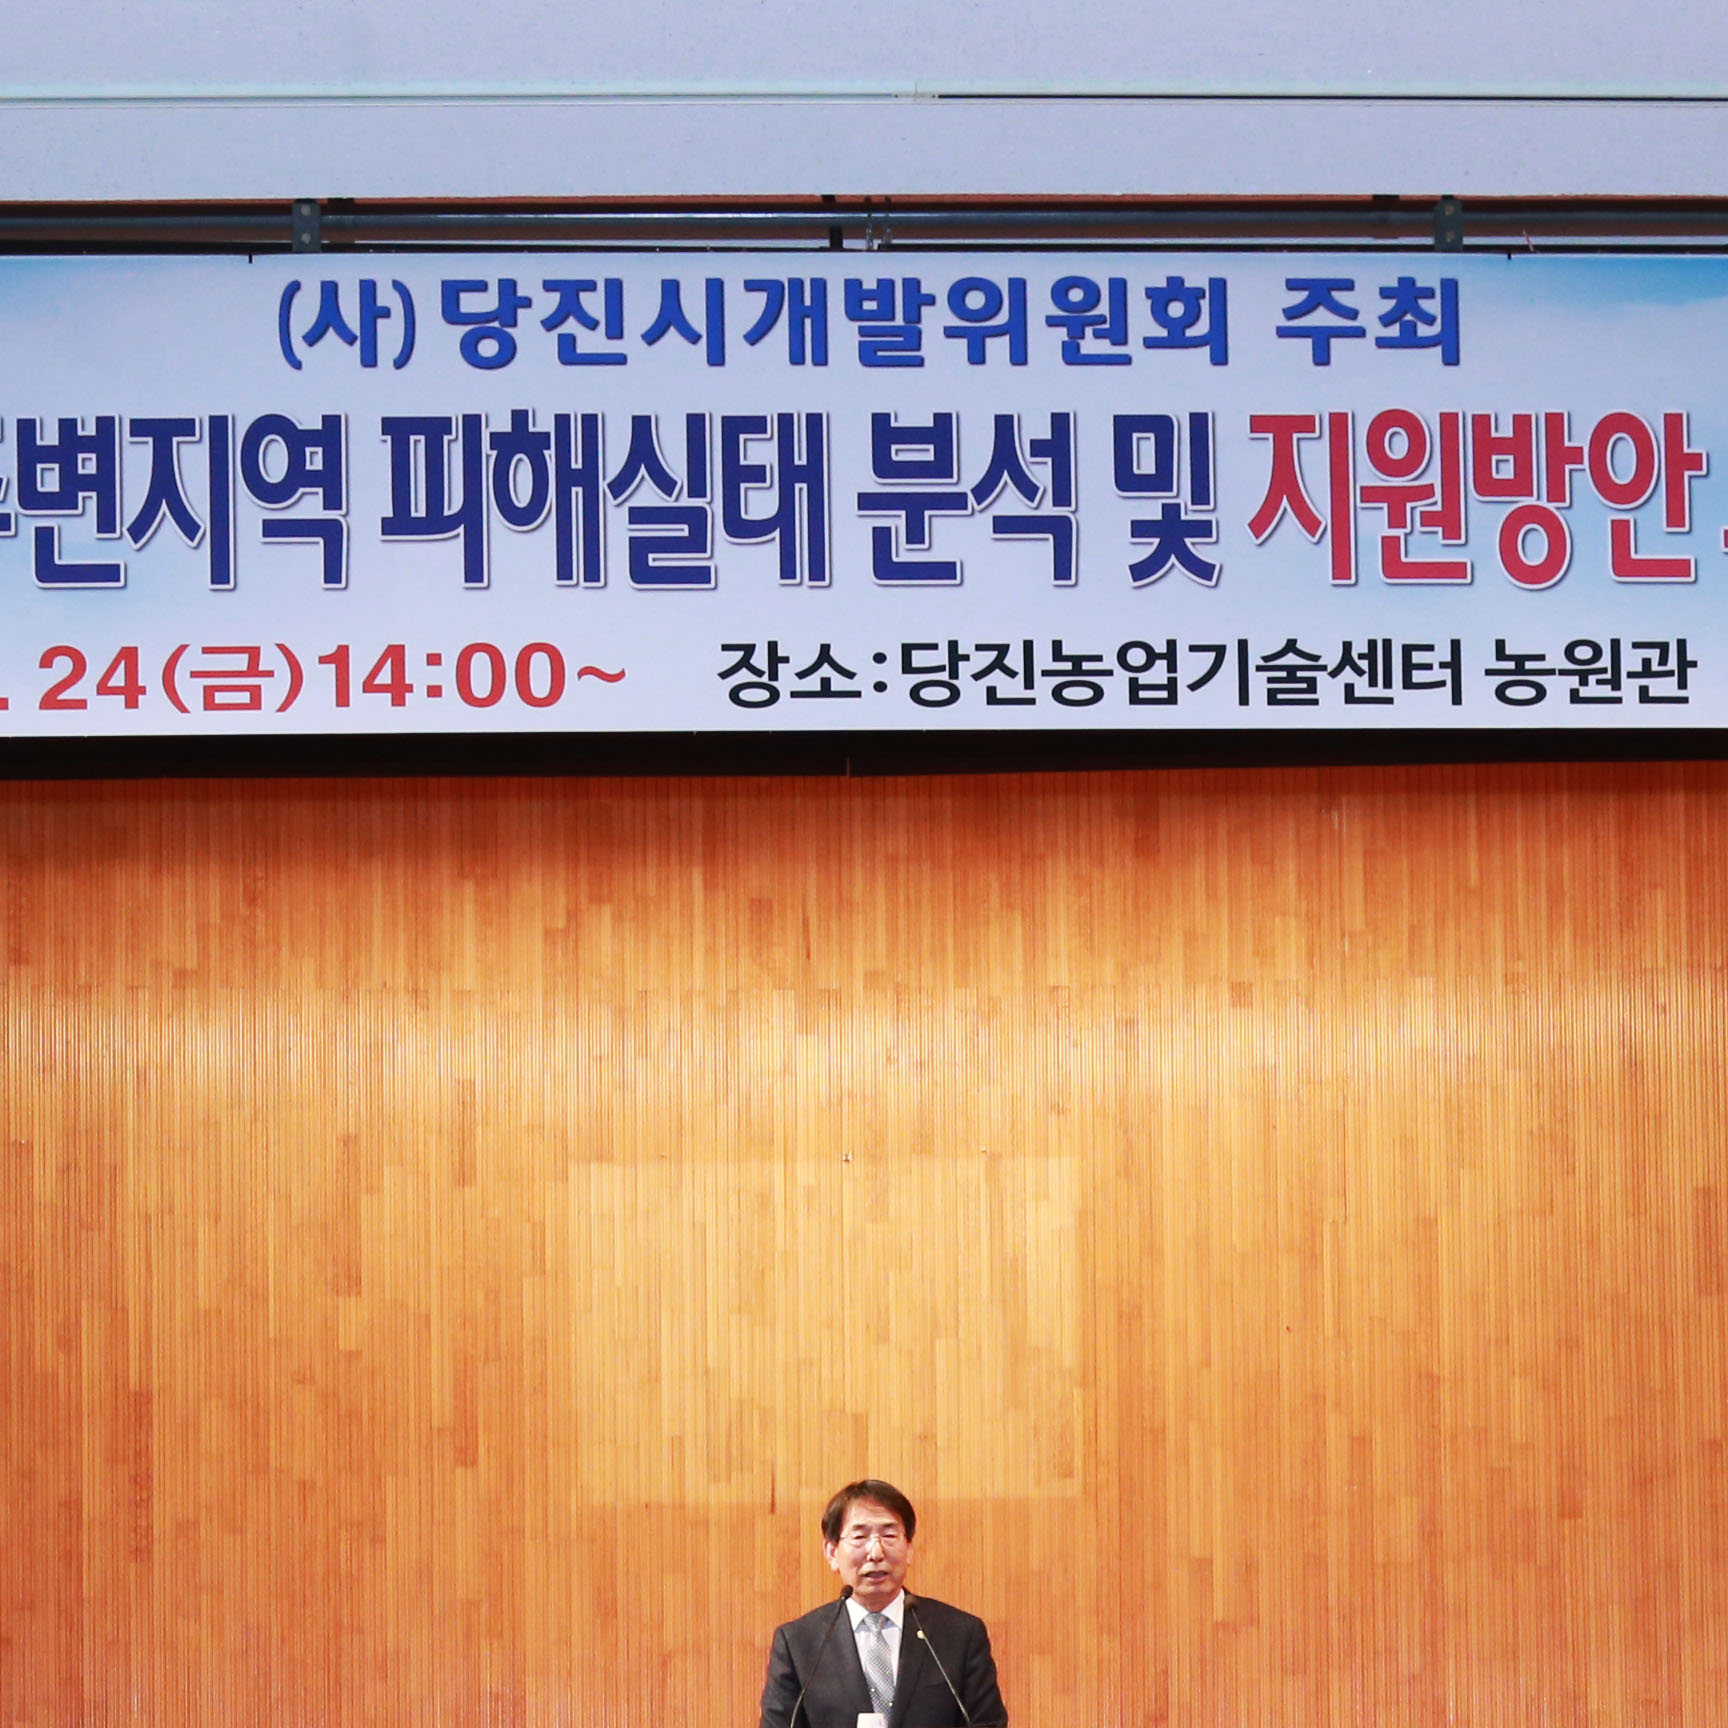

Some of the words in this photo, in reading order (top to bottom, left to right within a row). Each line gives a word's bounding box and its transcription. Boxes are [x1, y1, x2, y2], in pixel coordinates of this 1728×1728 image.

[279, 276, 1228, 370] (사)당진시개발위원회
[1276, 277, 1460, 366] 주최
[381, 409, 832, 591] 피해실태
[858, 413, 1079, 587] 분석
[1113, 412, 1222, 589] 및
[1248, 409, 1709, 591] 지원방안
[1485, 639, 1697, 706] 농원관
